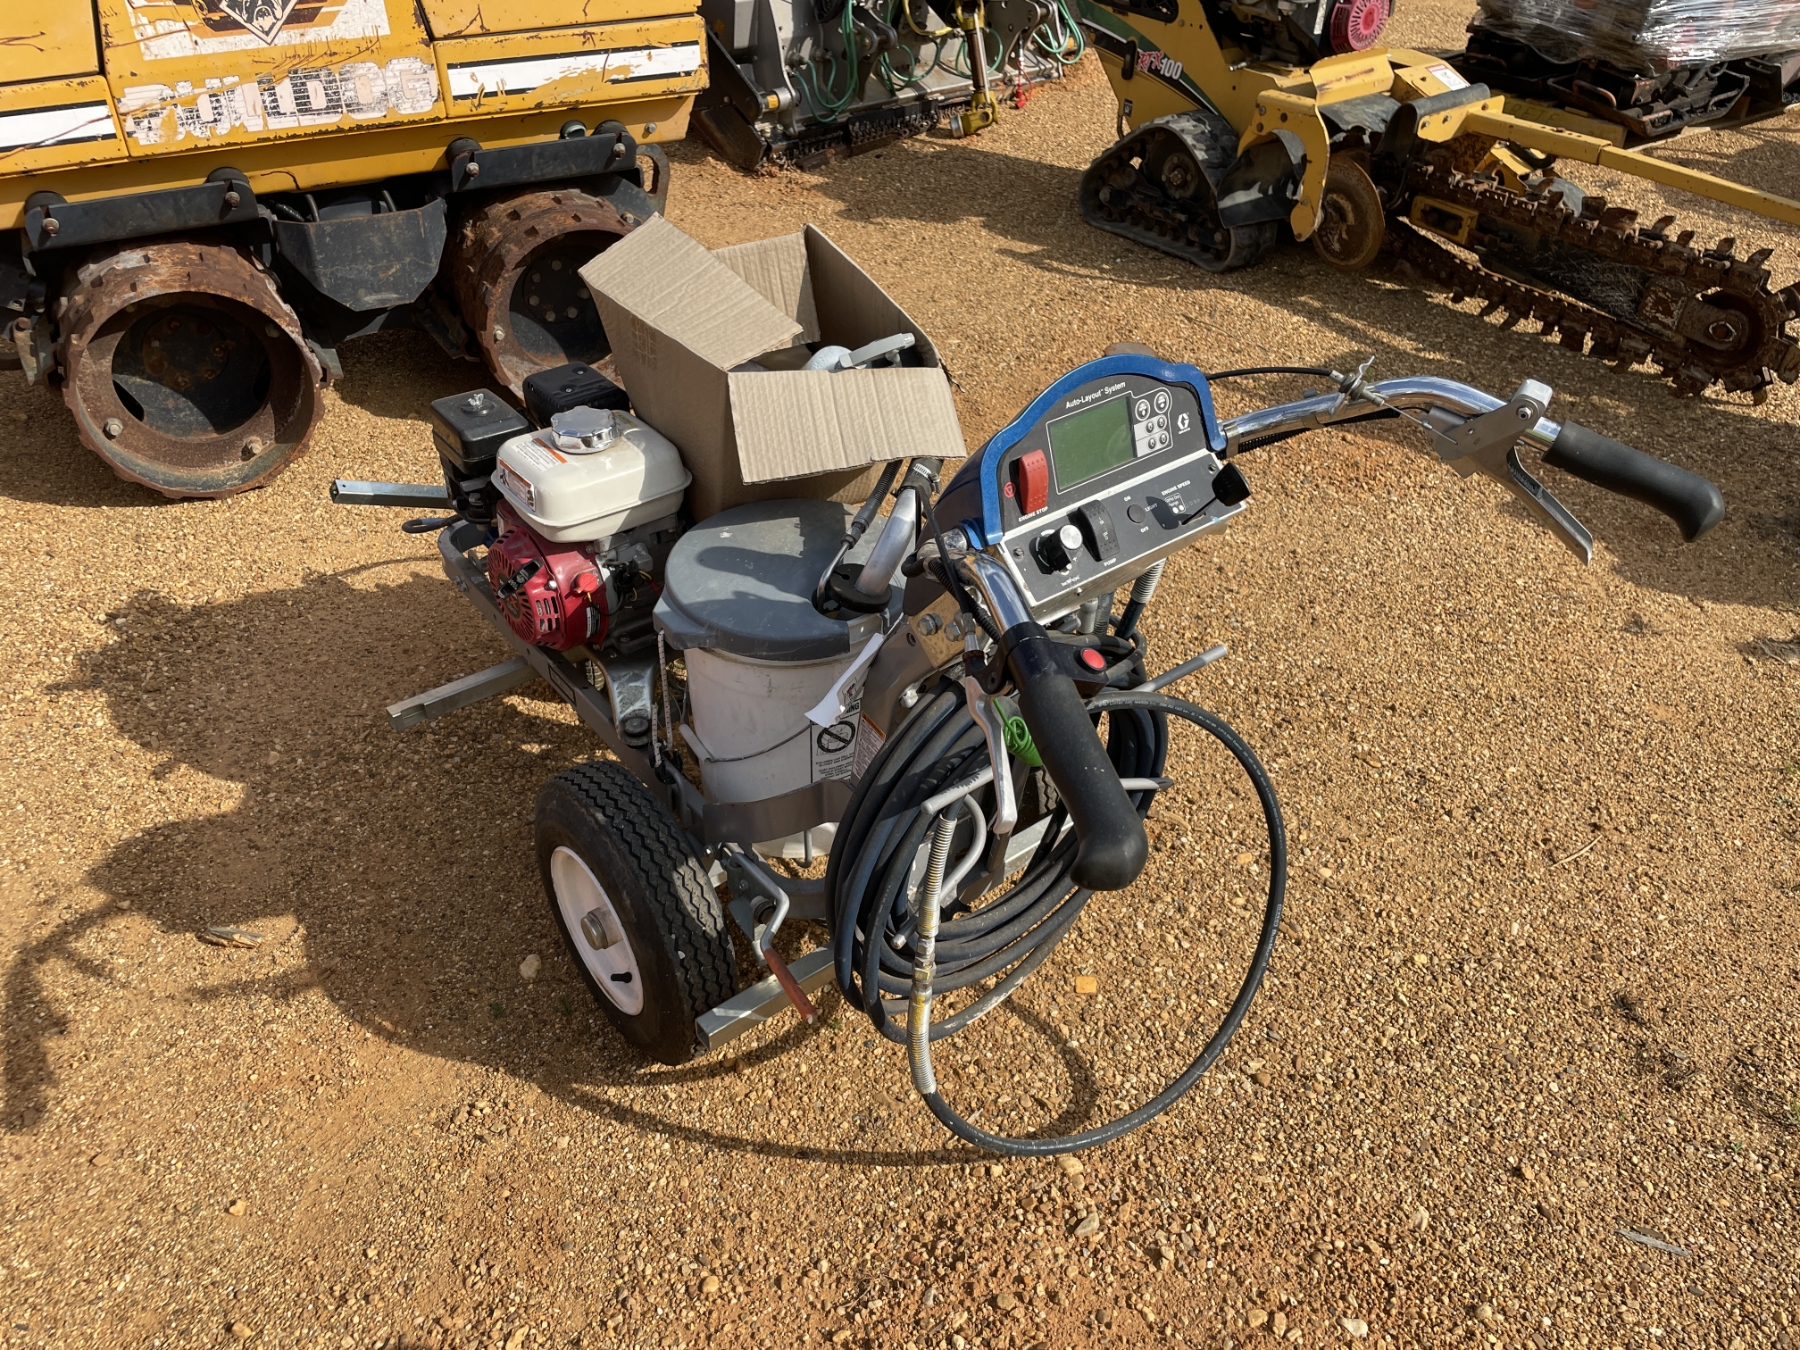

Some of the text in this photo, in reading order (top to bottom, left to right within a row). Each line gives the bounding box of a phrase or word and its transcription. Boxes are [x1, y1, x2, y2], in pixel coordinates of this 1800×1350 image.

[1104, 381, 1126, 395] System
[1018, 505, 1049, 522] ENGINE STOP
